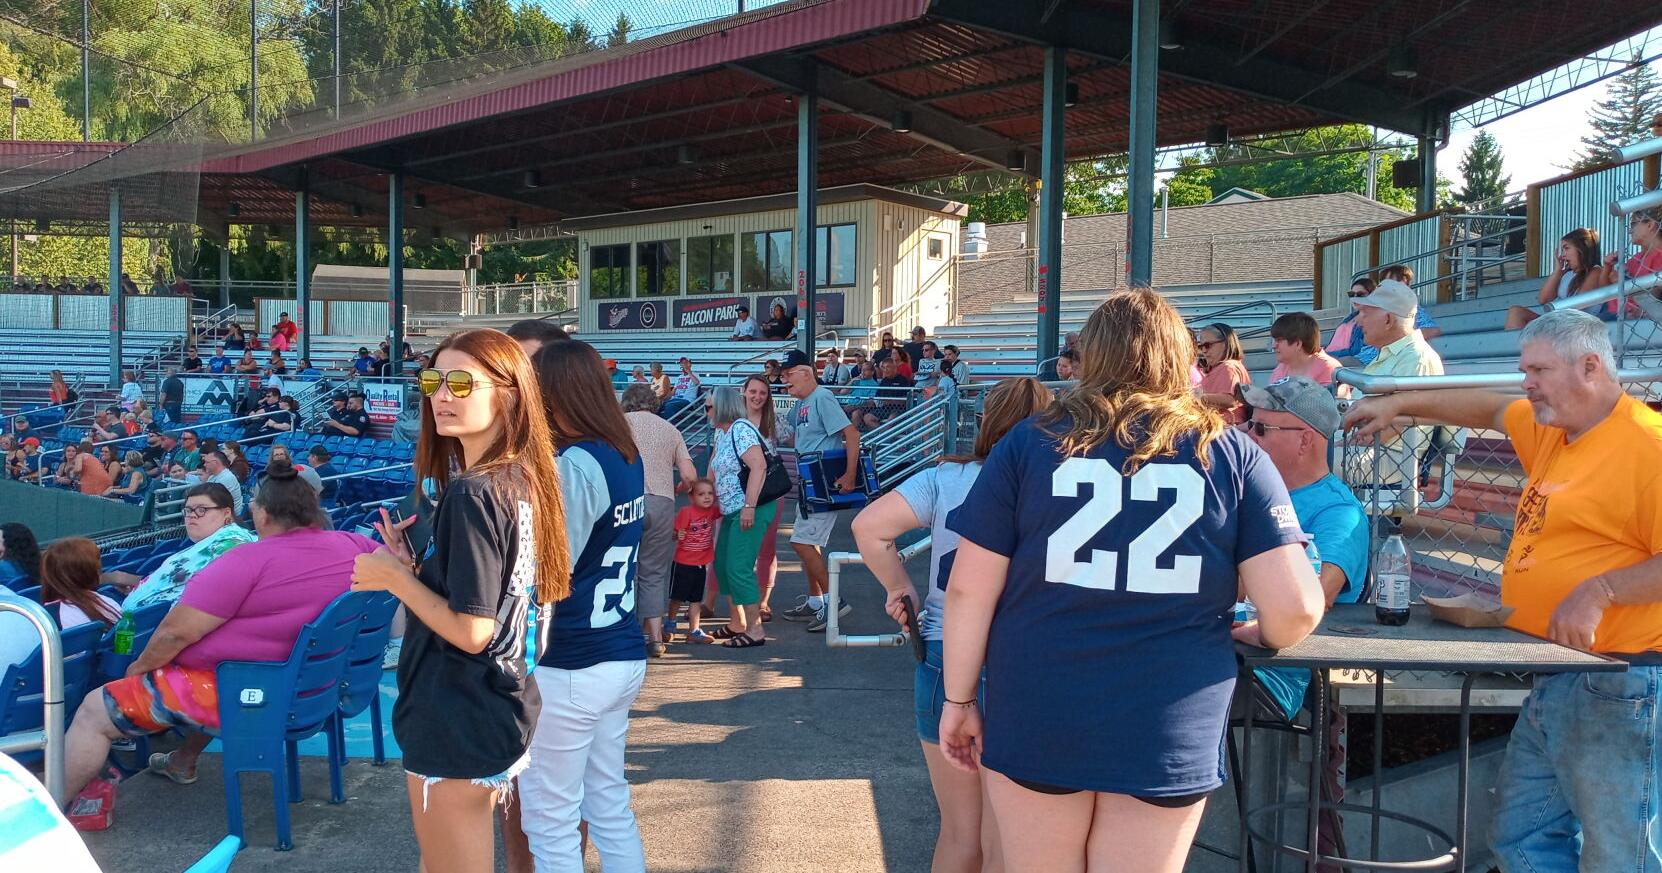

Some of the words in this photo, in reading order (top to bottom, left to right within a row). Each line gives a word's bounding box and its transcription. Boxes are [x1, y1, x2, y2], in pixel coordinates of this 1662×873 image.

[680, 308, 714, 327] FALCON
[714, 304, 740, 322] PARK
[383, 389, 400, 402] Rental
[1045, 457, 1206, 595] 22
[247, 690, 257, 702] E
